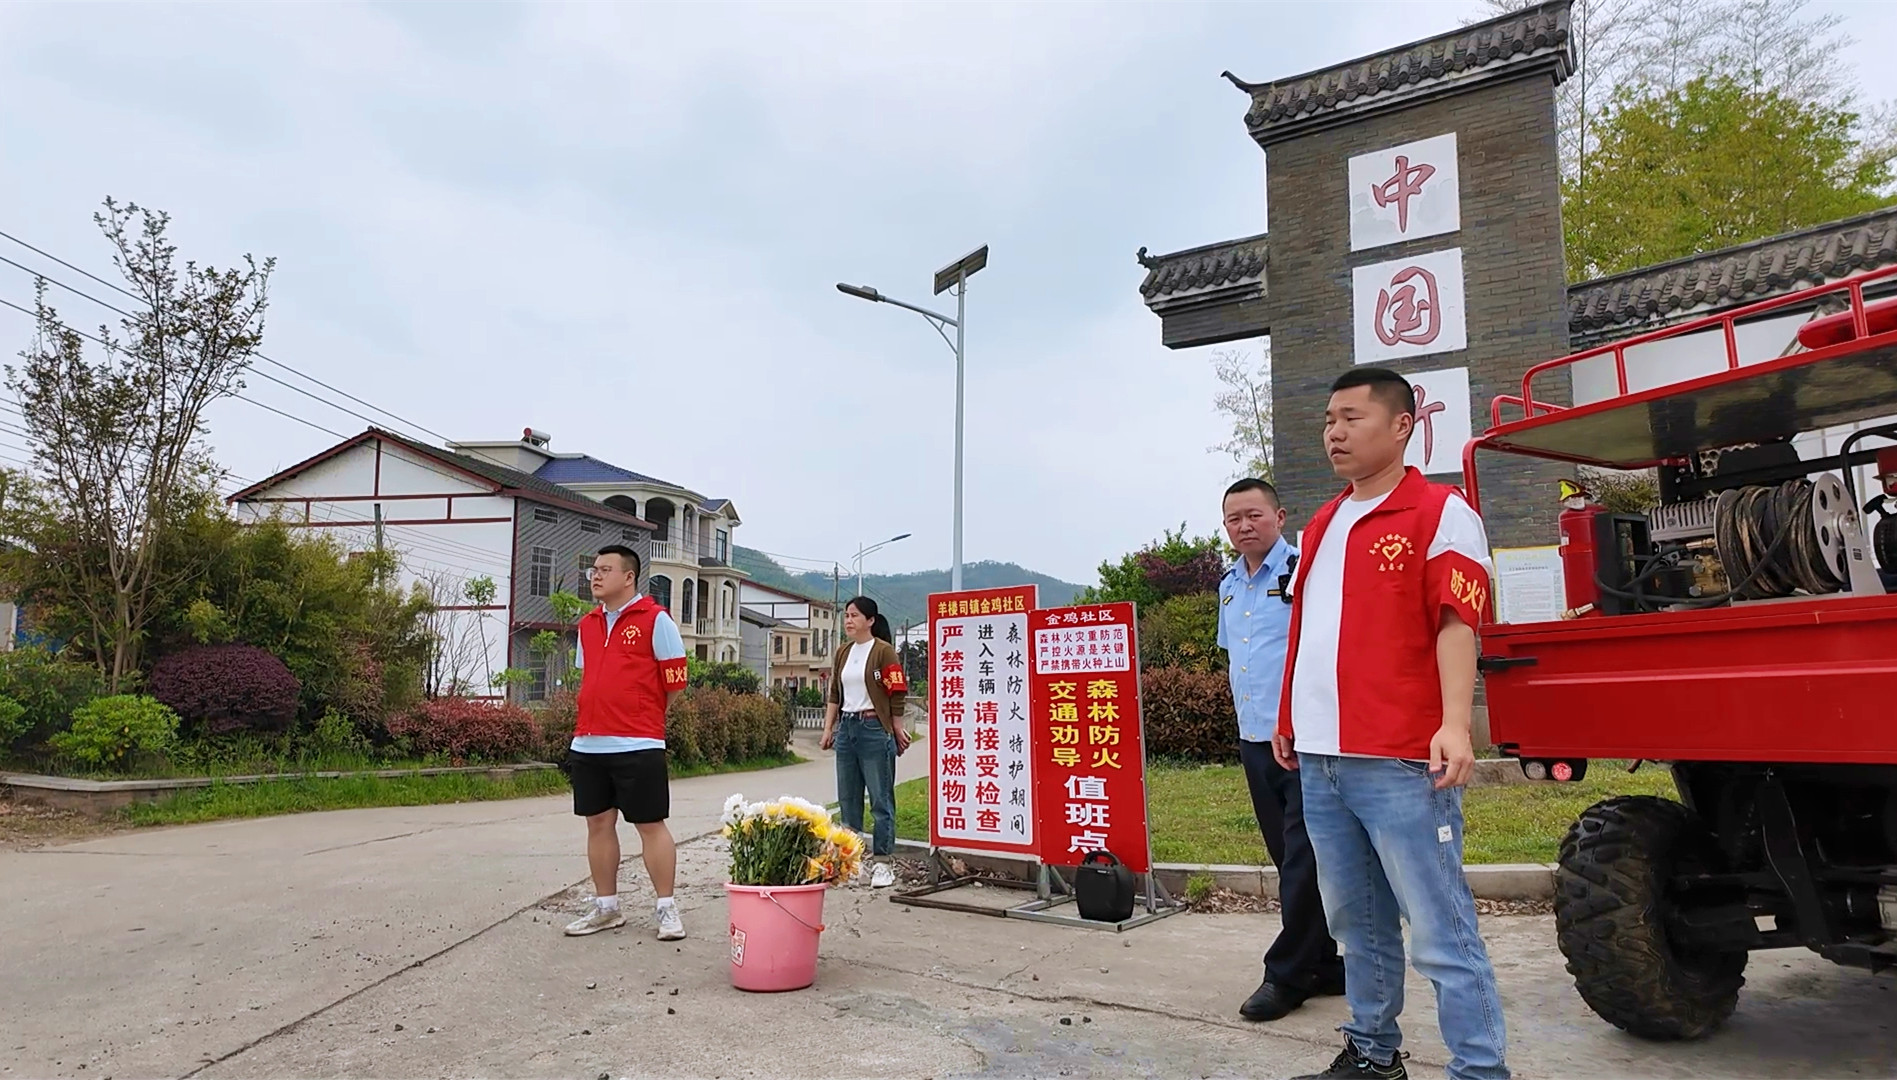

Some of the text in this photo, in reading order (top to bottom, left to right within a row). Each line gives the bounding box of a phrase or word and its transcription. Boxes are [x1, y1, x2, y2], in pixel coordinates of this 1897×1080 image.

[937, 595, 1025, 616] 羊楼司镇金鸡社区
[1039, 628, 1123, 644] 森林火灾重防范
[1044, 609, 1116, 626] 金鸡社区
[1040, 643, 1124, 657] 严控火源是关键
[1040, 658, 1125, 671] 严禁携带火种上山
[940, 625, 967, 831] 严禁携带易燃物品
[973, 624, 1001, 833] 进入车辆 请接受检查
[1005, 622, 1026, 836] 森林防火 特护期间
[1048, 680, 1081, 768] 交通劝导
[1086, 679, 1123, 769] 森林防火
[1064, 775, 1111, 854] 值班点
